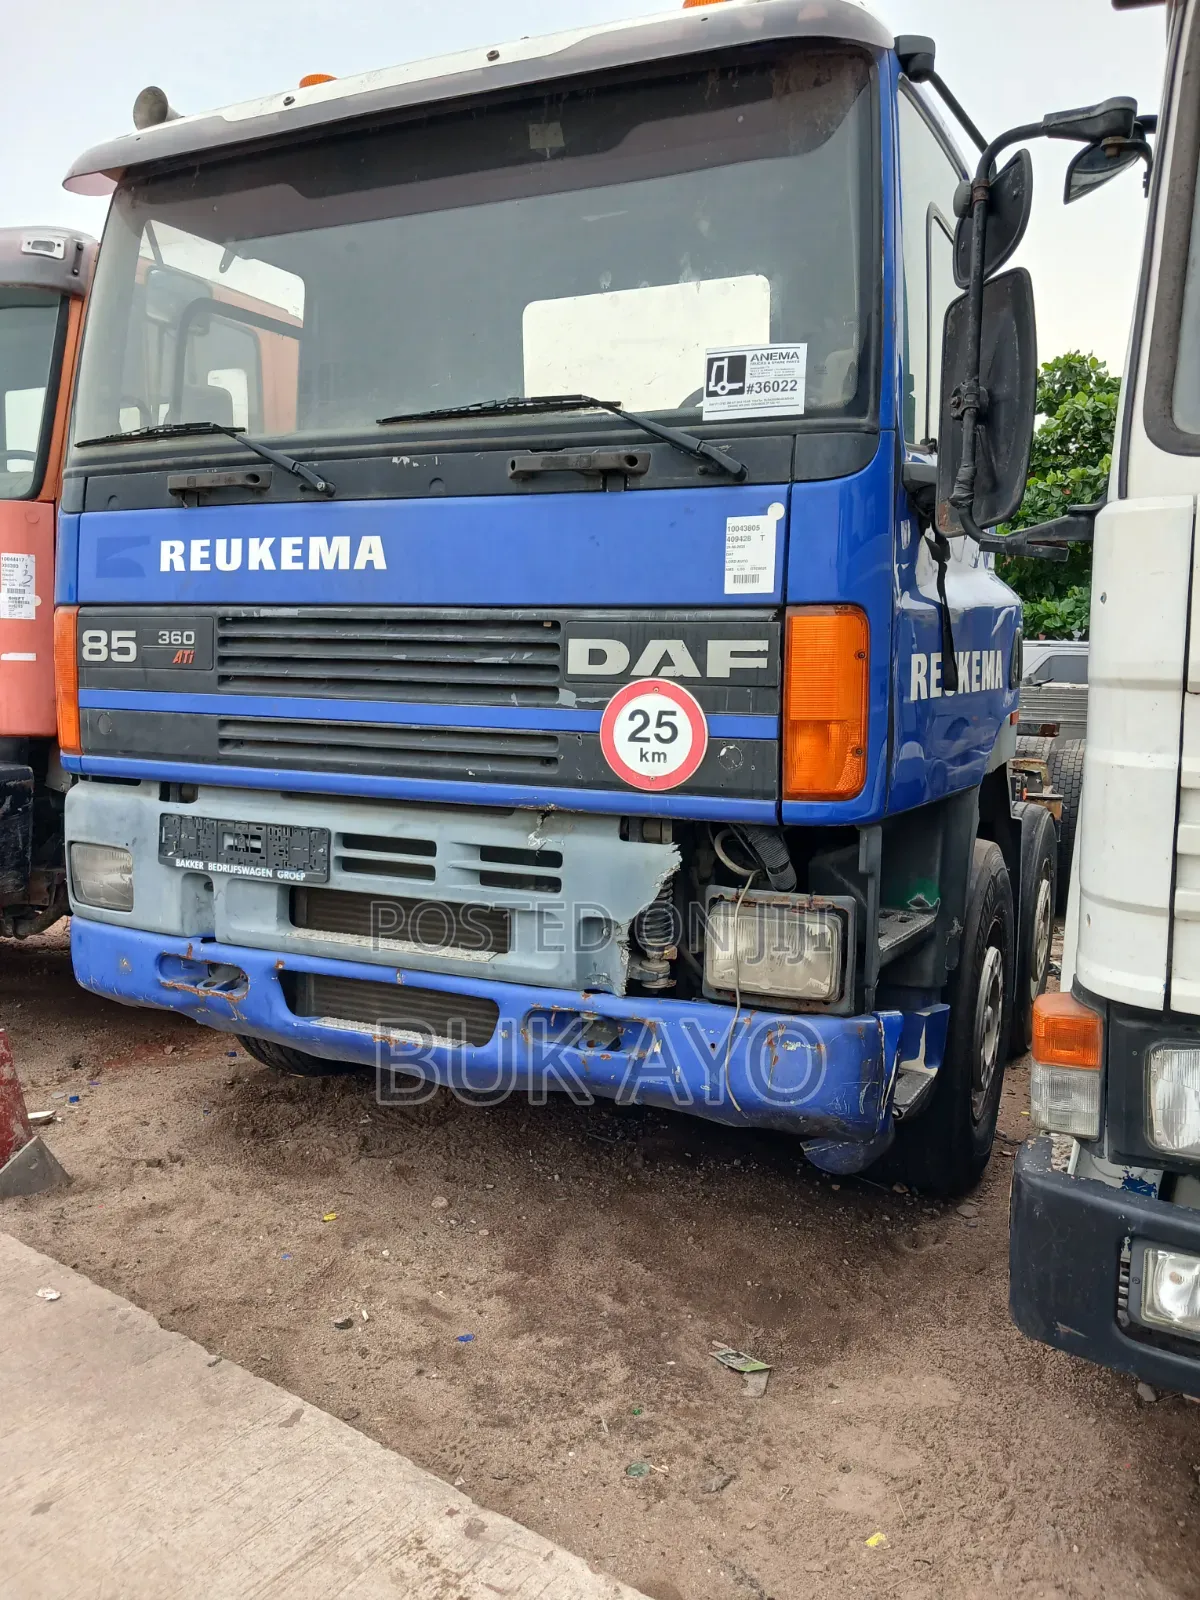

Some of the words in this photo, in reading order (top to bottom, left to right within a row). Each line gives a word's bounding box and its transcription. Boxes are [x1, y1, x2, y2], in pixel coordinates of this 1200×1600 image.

[750, 351, 800, 362] ANEMA
[746, 379, 798, 394] #36022
[159, 535, 387, 572] REUKEMA
[82, 629, 137, 663] 85
[158, 630, 195, 645] 360
[172, 650, 195, 664] ATi
[567, 638, 769, 678] DAF
[910, 650, 1003, 701] REKEMA
[627, 708, 679, 745] 25
[639, 748, 667, 763] km
[175, 858, 204, 870] BAKKER
[208, 863, 273, 878] BEDRIJFSWAGEN
[277, 870, 306, 881] GROEP
